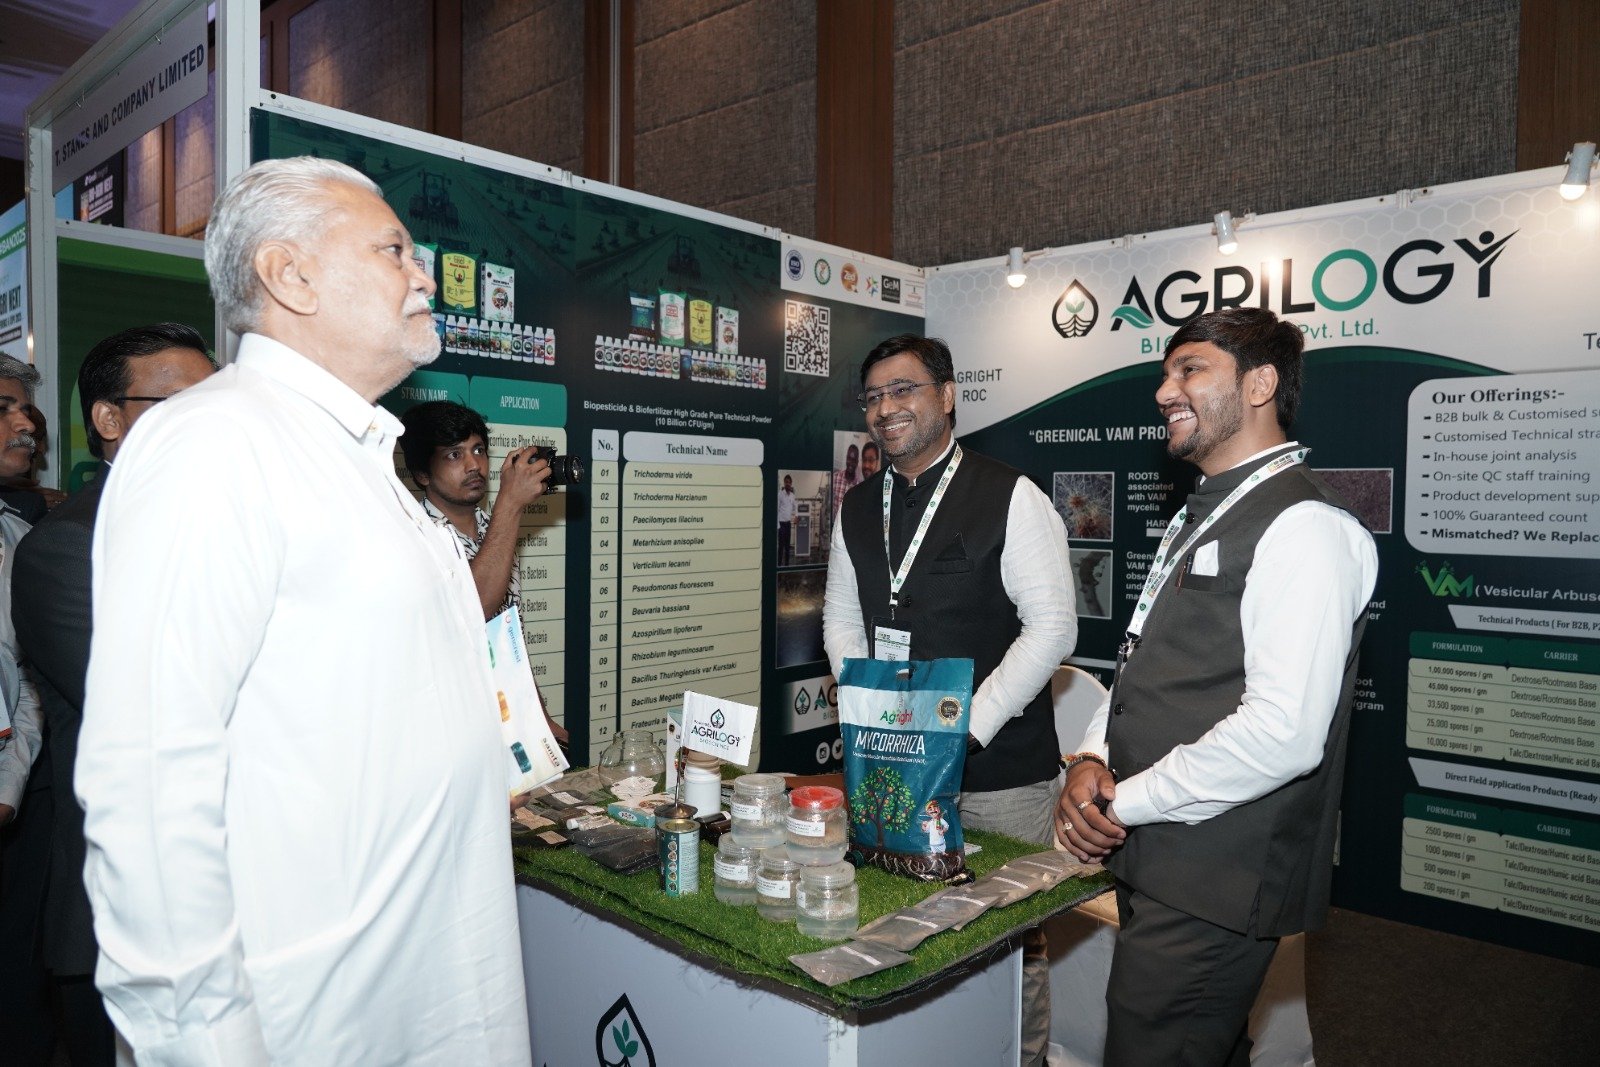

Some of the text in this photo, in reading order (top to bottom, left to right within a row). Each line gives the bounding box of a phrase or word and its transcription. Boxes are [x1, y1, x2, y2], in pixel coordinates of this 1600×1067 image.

[55, 44, 204, 166] T. STANES AND COMPANY LIMITED
[1110, 228, 1520, 332] AGRILOGY
[1341, 318, 1379, 338] Ltd.
[954, 368, 1002, 384] GRIGHT
[402, 387, 448, 400] STRAIN NAME
[962, 389, 987, 402] ROC
[1432, 388, 1565, 404] Our Offerings:-
[500, 396, 540, 410] APPLICATION
[584, 400, 772, 424] Biopesticide & Biofertilizer High Grade Pure Technical Powder
[1435, 407, 1587, 422] B2B bulk & Customised
[656, 416, 666, 427] (10
[666, 418, 687, 428] Billion
[1106, 426, 1134, 442] VAM
[1434, 430, 1507, 442] Customised
[1512, 428, 1574, 440] Technical
[598, 439, 728, 456] No. Technical Name
[1433, 450, 1577, 464] In-house joint analysis
[600, 469, 610, 477] 01
[634, 470, 674, 478] Trichoderma
[1128, 472, 1160, 480] ROOTS
[1433, 470, 1590, 483] On-site QC staff training
[1128, 482, 1174, 490] associated
[600, 492, 610, 500] 02
[634, 492, 708, 501] Trichoderma Harzianum
[1433, 490, 1600, 504] Product development sup
[1128, 504, 1160, 512] mycelia
[600, 516, 609, 524] 03
[678, 516, 704, 524] lilacinus
[1433, 510, 1588, 522] 100% Guaranteed count
[528, 532, 548, 548] Bacteria
[1431, 528, 1519, 540] Mismatched?
[1524, 530, 1546, 541] We
[600, 540, 608, 548] 04
[600, 563, 608, 572] 05
[1126, 562, 1146, 570] VAM
[526, 566, 548, 580] Bacteria
[600, 586, 608, 595] 06
[632, 584, 678, 593] Pseudomonas
[1484, 585, 1548, 598] Vesicular
[526, 598, 548, 612] Bacteria
[600, 610, 608, 619] 07
[1478, 615, 1514, 625] Technical
[1515, 617, 1550, 628] Products
[1556, 620, 1570, 629] For
[527, 630, 548, 644] Bacteria
[599, 634, 608, 642] 08
[1432, 641, 1483, 653] FORMULATION
[599, 657, 608, 666] 09
[632, 652, 666, 662] Rhizobium
[1544, 650, 1578, 662] CARRIER
[632, 674, 658, 684] Bacillus
[660, 668, 700, 681] Thuringiensis
[712, 662, 737, 672] Kurstaki
[1455, 670, 1478, 678] spores
[600, 680, 608, 688] 10
[1512, 673, 1597, 691] Dextrose/Rootmass Base
[1450, 685, 1472, 694] spores
[632, 697, 658, 707] Bacillus
[1511, 690, 1596, 708] Dextrose/Rootmass Base
[600, 704, 607, 712] 11
[1450, 703, 1470, 713] spores
[1510, 708, 1596, 727] Dextrose/Rootmass Base
[599, 726, 608, 735] 12
[1450, 722, 1470, 732] spores
[691, 724, 740, 747] AGRILOGY
[855, 730, 926, 755] MYCORRHIZA
[1445, 772, 1598, 804] Direct Field application Products (Ready
[1426, 805, 1477, 820] FORMULATION
[1536, 824, 1571, 836] CARRIER
[1571, 853, 1586, 864] acid
